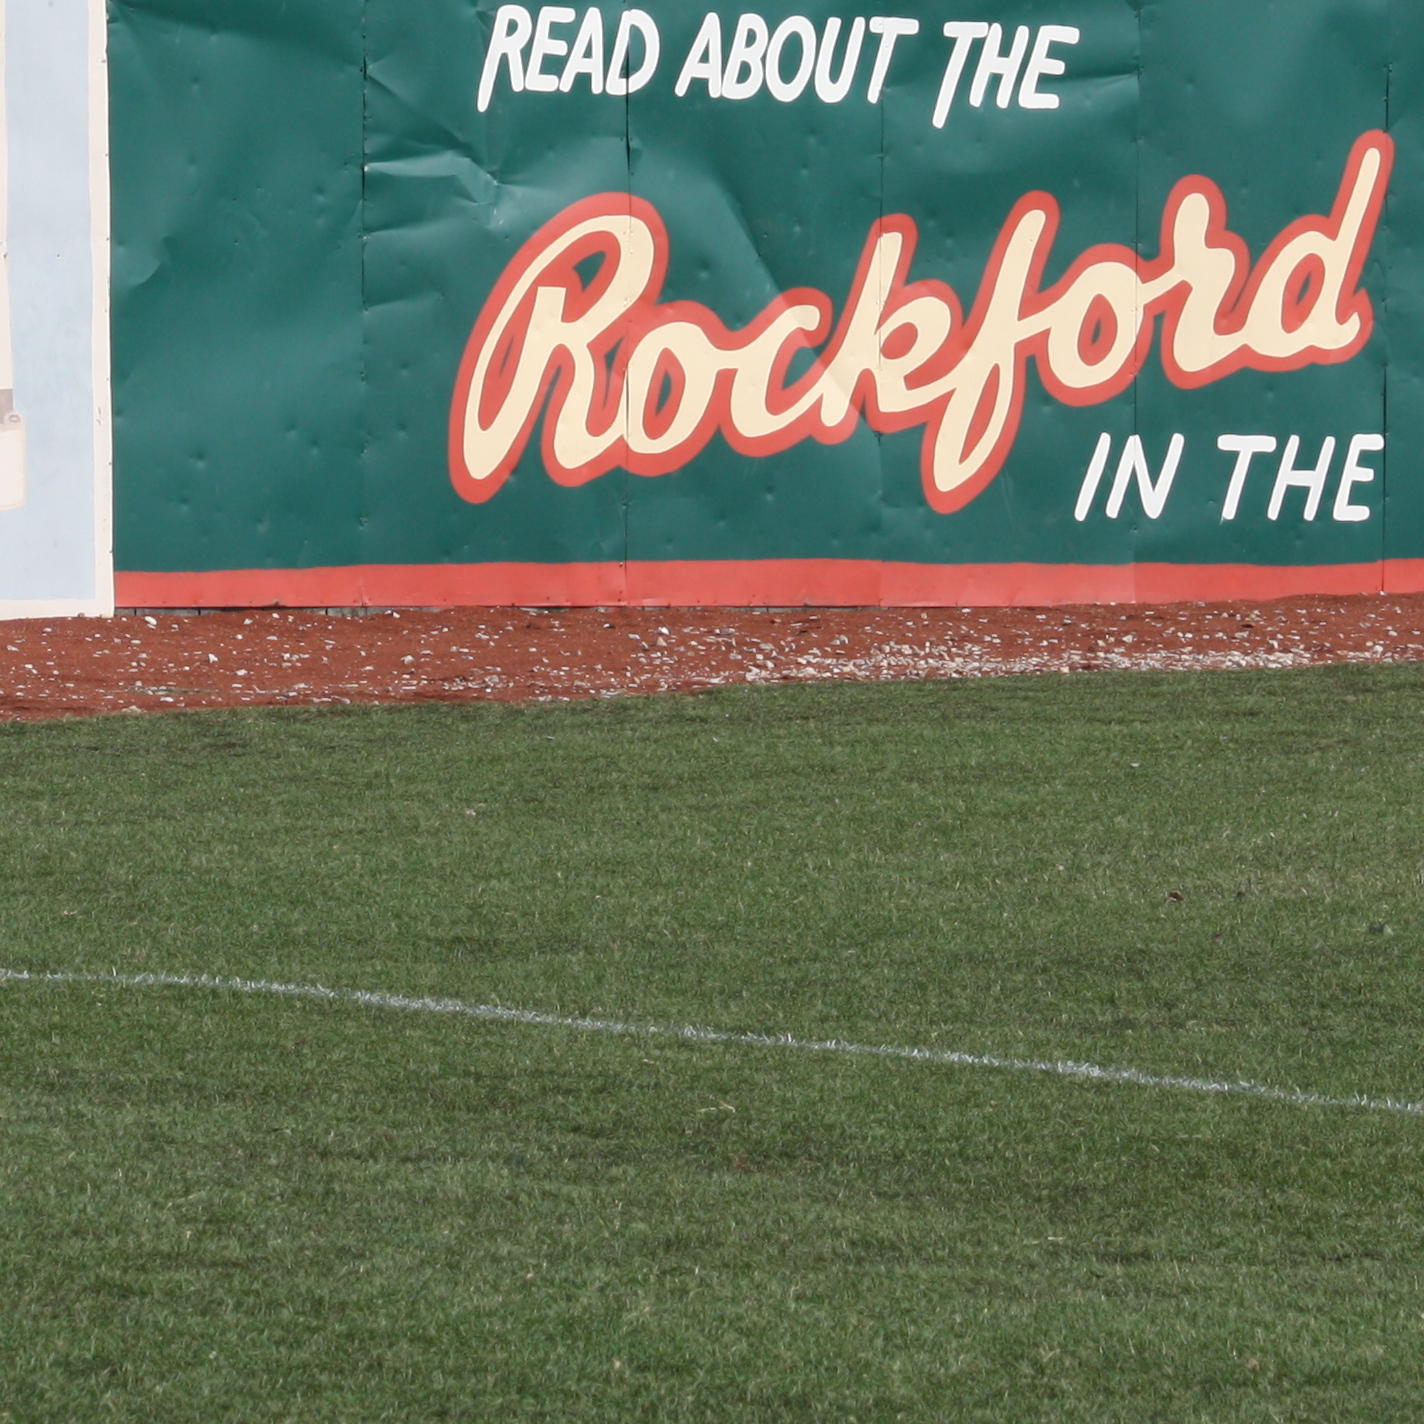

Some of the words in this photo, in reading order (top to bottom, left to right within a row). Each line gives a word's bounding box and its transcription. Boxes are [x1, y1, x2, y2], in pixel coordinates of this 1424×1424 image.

[478, 5, 659, 112] READ
[675, 12, 919, 103] ABOUT
[933, 22, 1079, 128] THE
[449, 130, 1394, 514] Rockford
[1075, 433, 1184, 521] IN
[1218, 434, 1384, 521] THE
